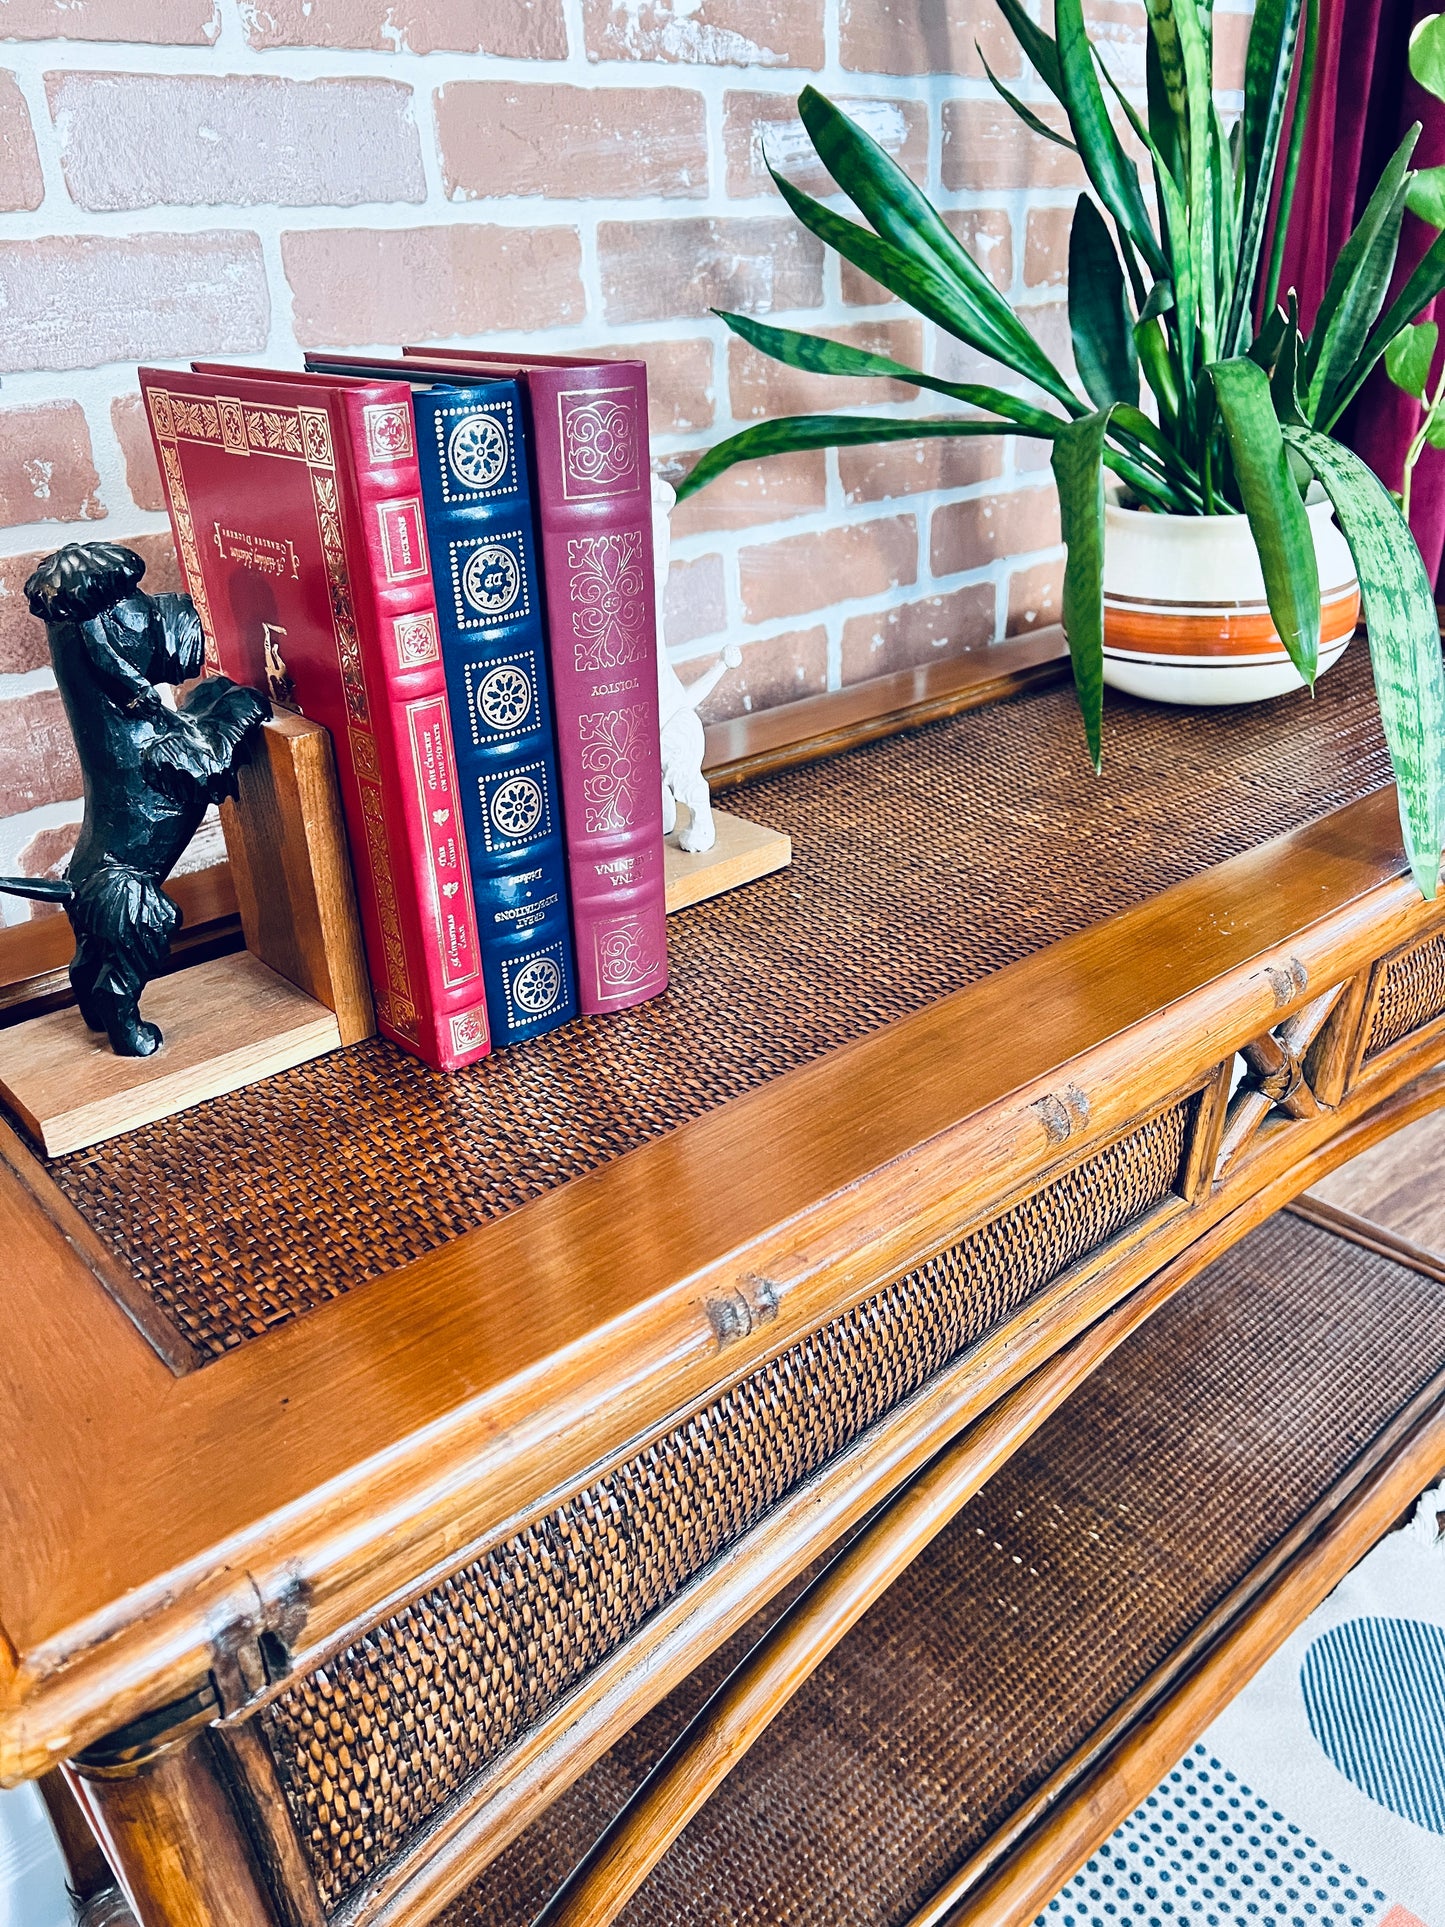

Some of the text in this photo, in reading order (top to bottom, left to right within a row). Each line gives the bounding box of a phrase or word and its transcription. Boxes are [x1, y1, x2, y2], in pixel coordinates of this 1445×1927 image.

[276, 556, 286, 576] A
[484, 572, 504, 588] DP
[591, 677, 639, 697] TOLSTOY
[423, 731, 435, 769] CRICKET
[433, 722, 445, 760] HEARTH
[594, 850, 653, 875] ENINA
[508, 867, 543, 887] Dickens
[494, 893, 558, 923] EXPECTATIONS
[516, 911, 545, 929] GREAT
